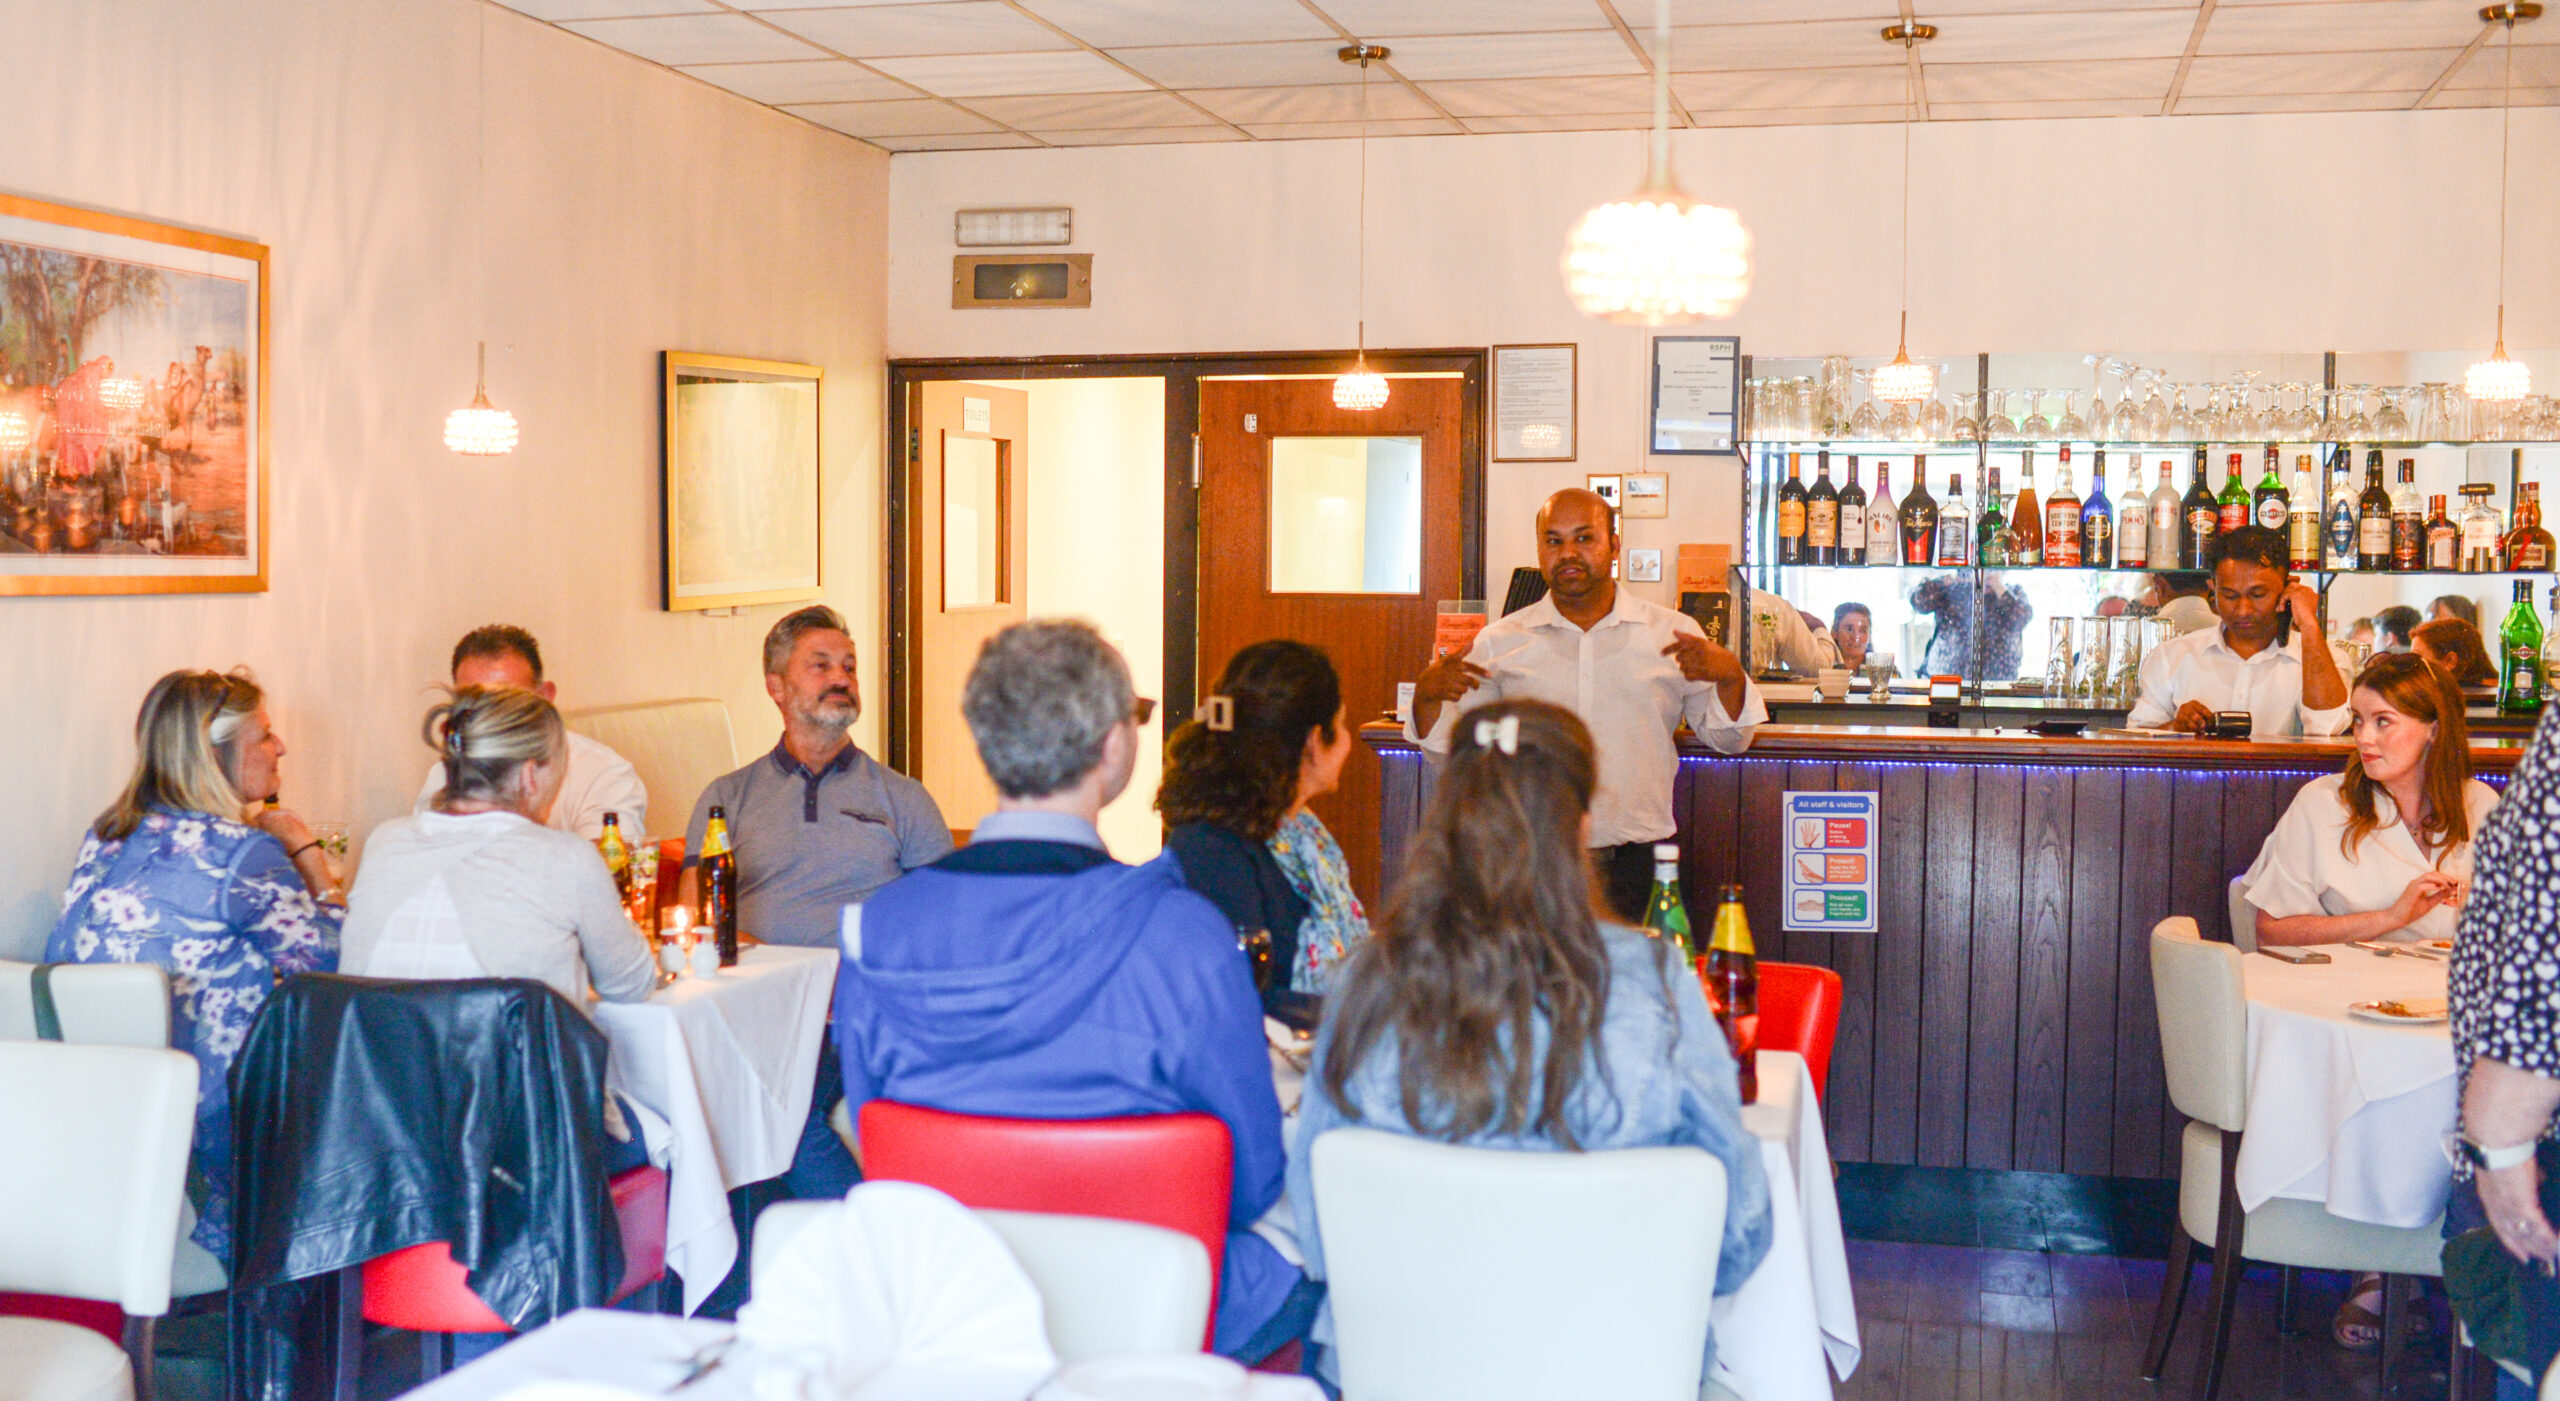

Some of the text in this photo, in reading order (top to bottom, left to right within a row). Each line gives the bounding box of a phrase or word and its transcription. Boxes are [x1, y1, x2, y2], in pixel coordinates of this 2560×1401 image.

[965, 408, 989, 422] TOILETS
[2051, 519, 2077, 527] COMORT
[2122, 514, 2145, 525] PIMM'S
